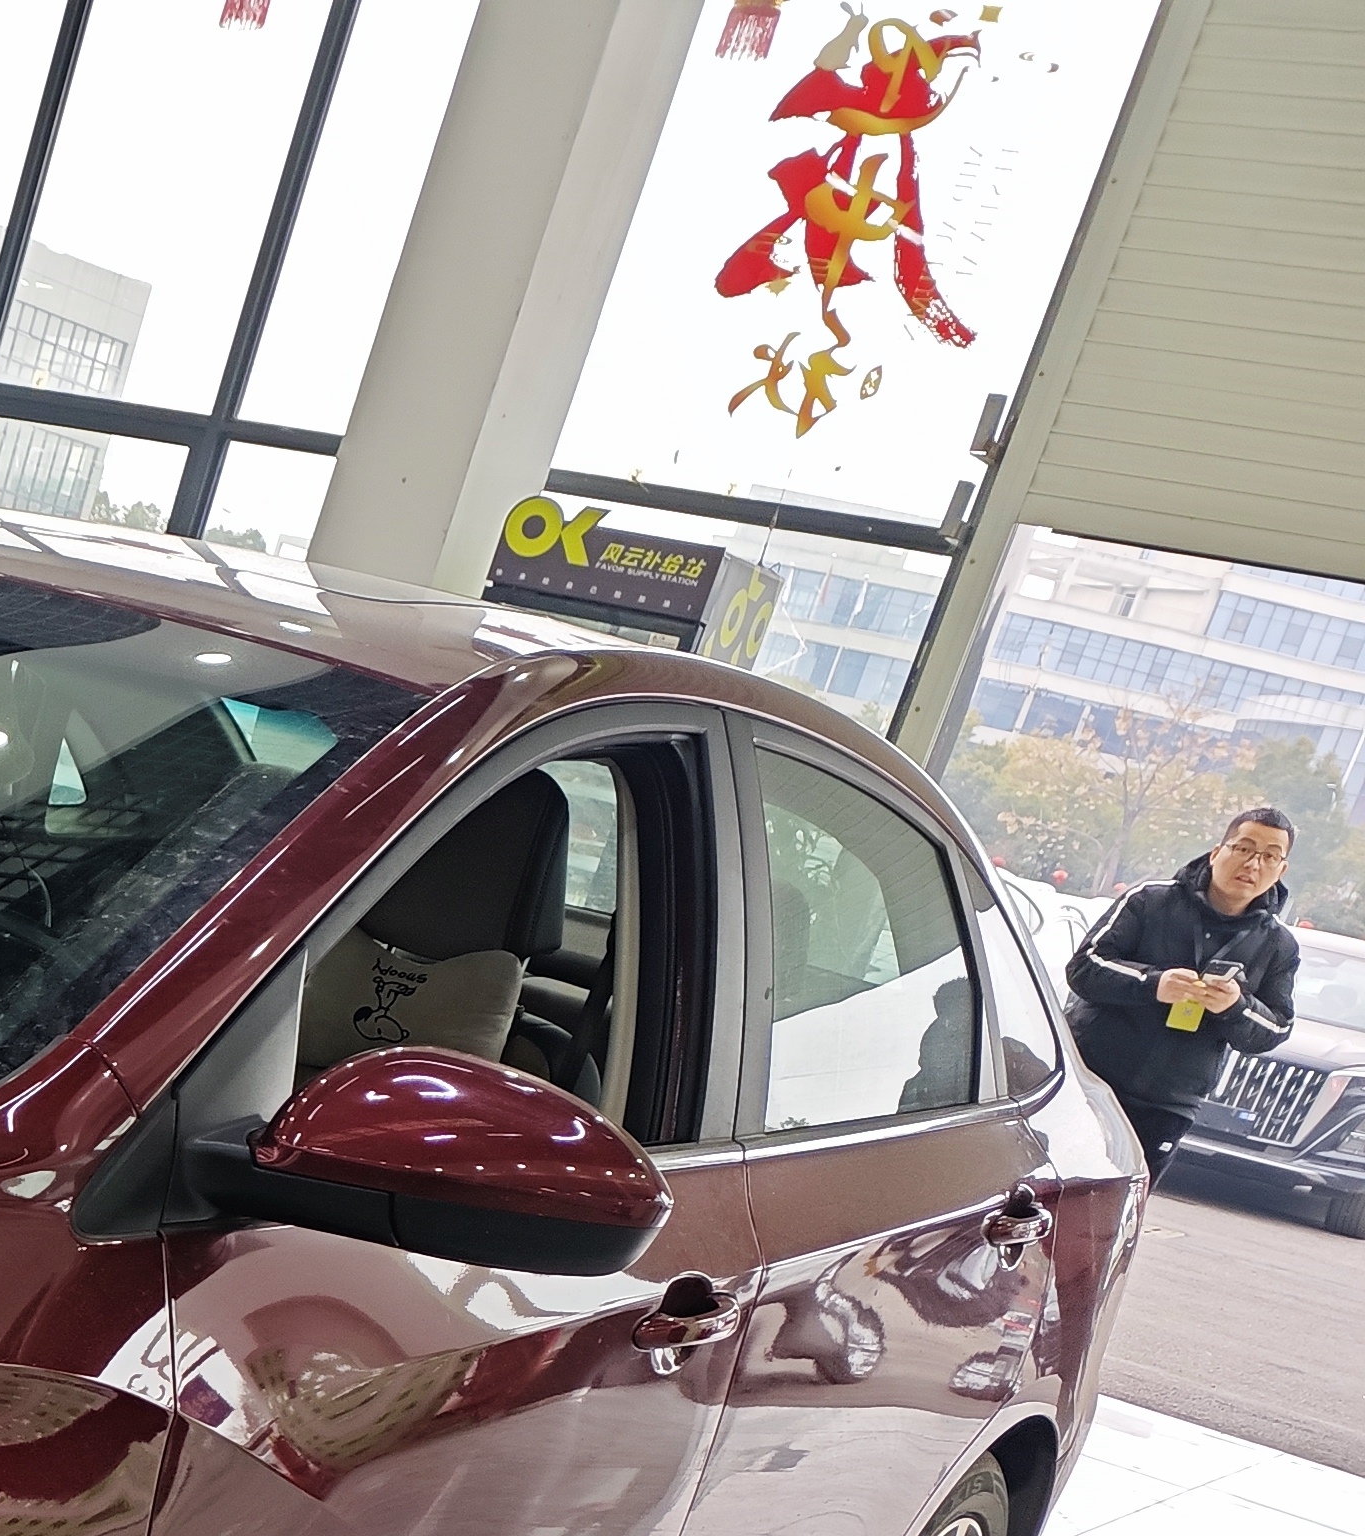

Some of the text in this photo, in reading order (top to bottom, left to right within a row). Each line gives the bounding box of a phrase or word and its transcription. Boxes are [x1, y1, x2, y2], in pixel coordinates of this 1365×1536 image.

[505, 496, 611, 567] OK
[595, 561, 698, 587] FAVOR SUPPLY STATION
[600, 542, 707, 579] 风云补给站
[372, 957, 428, 984] Snoopy
